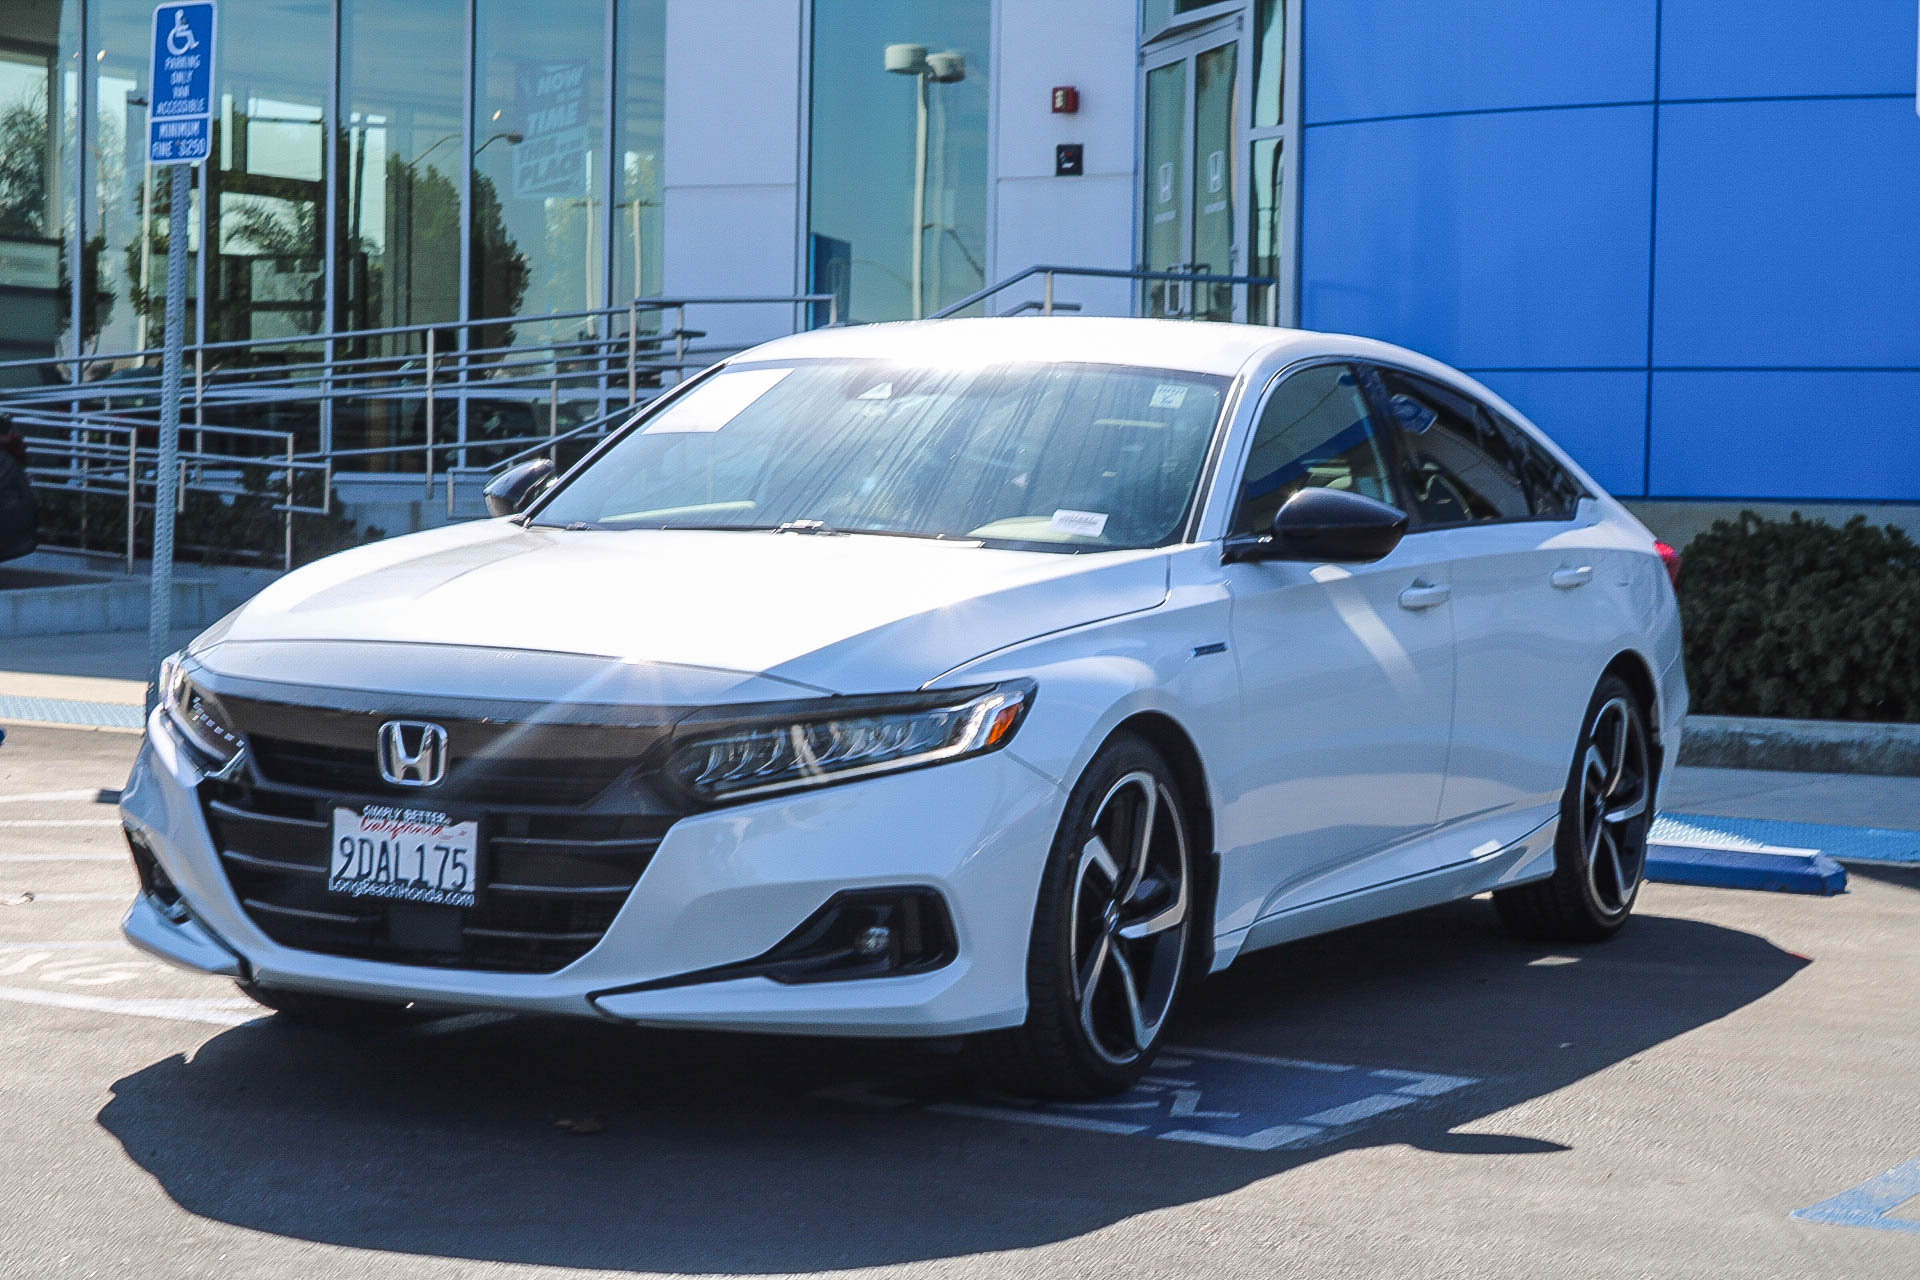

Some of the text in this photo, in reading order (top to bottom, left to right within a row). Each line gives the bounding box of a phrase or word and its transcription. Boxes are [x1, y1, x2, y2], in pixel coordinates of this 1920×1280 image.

[165, 55, 200, 70] PARKING
[170, 71, 193, 85] ONLY
[173, 86, 190, 99] VAN
[156, 99, 205, 115] ACCESSIBLE
[159, 121, 200, 139] MINIMUM
[152, 139, 206, 158] FINE $250
[363, 804, 403, 822] SIMPLY
[337, 835, 468, 891] 9DAL175
